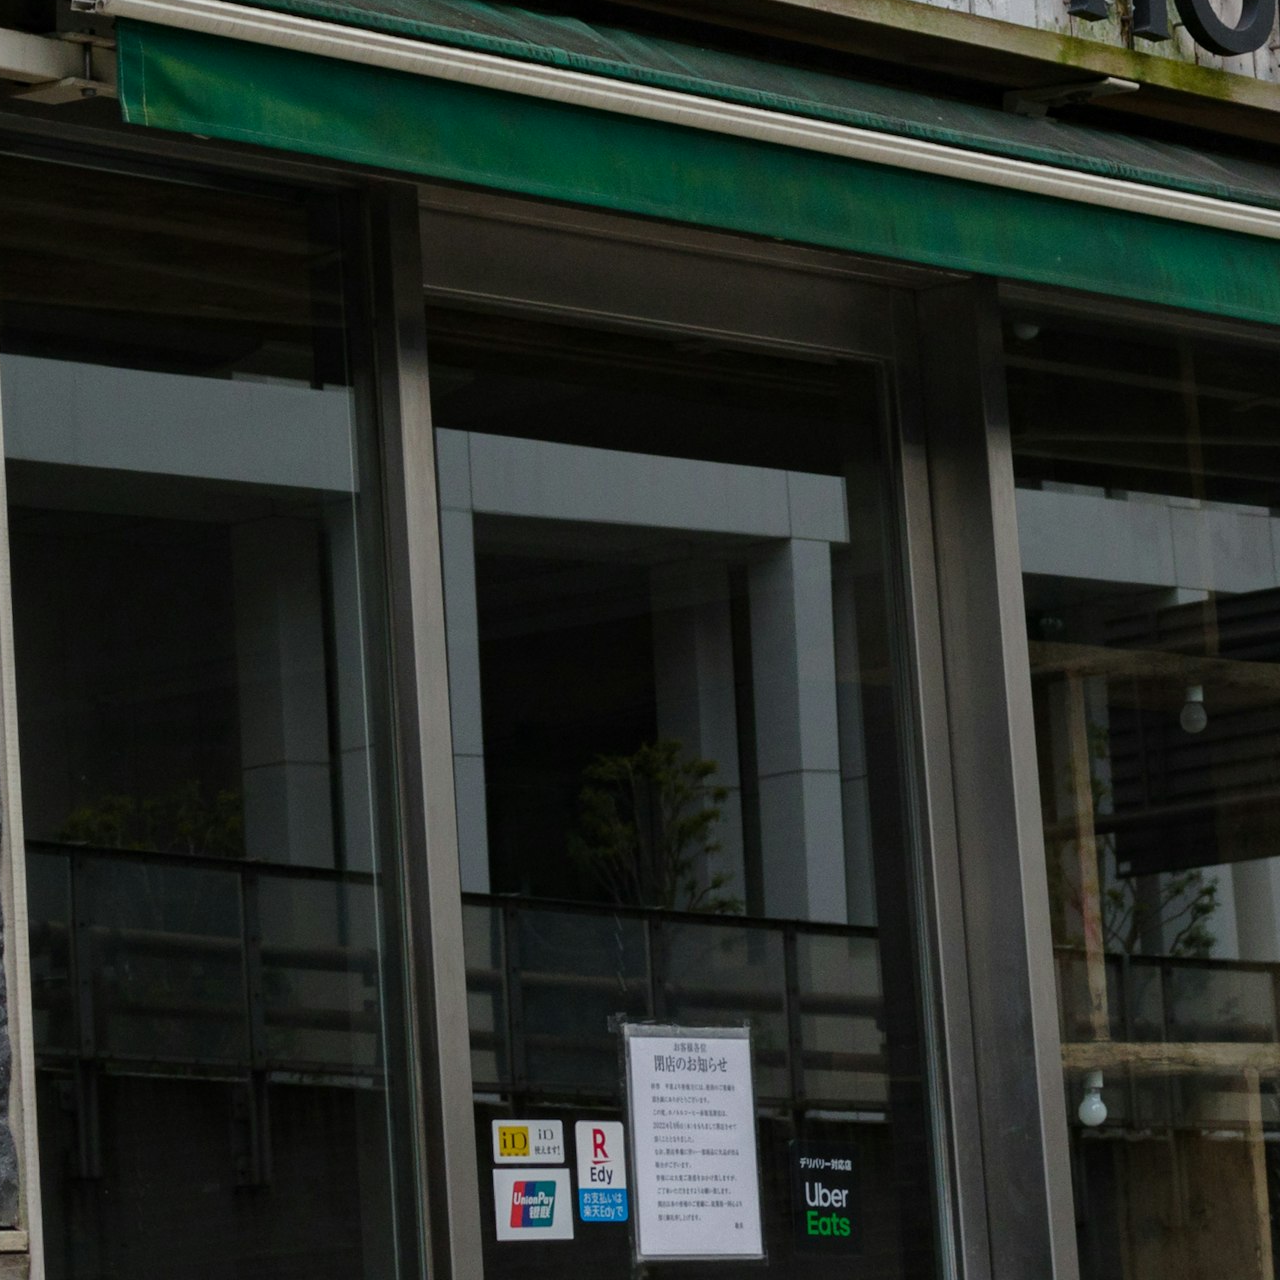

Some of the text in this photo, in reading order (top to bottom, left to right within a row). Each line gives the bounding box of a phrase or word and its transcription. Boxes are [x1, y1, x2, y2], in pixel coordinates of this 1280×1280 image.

[654, 1055, 728, 1073] 閉店のお知らせ
[503, 1131, 527, 1150] iD
[538, 1129, 554, 1141] iD
[592, 1128, 609, 1158] R
[799, 1157, 852, 1171] デリバリー対応店
[590, 1166, 613, 1185] Edy
[513, 1191, 555, 1207] UnionPay
[583, 1192, 623, 1204] お支払いは
[805, 1181, 849, 1208] Uber
[583, 1206, 624, 1220] 楽天Edyで
[807, 1210, 851, 1236] Eats
